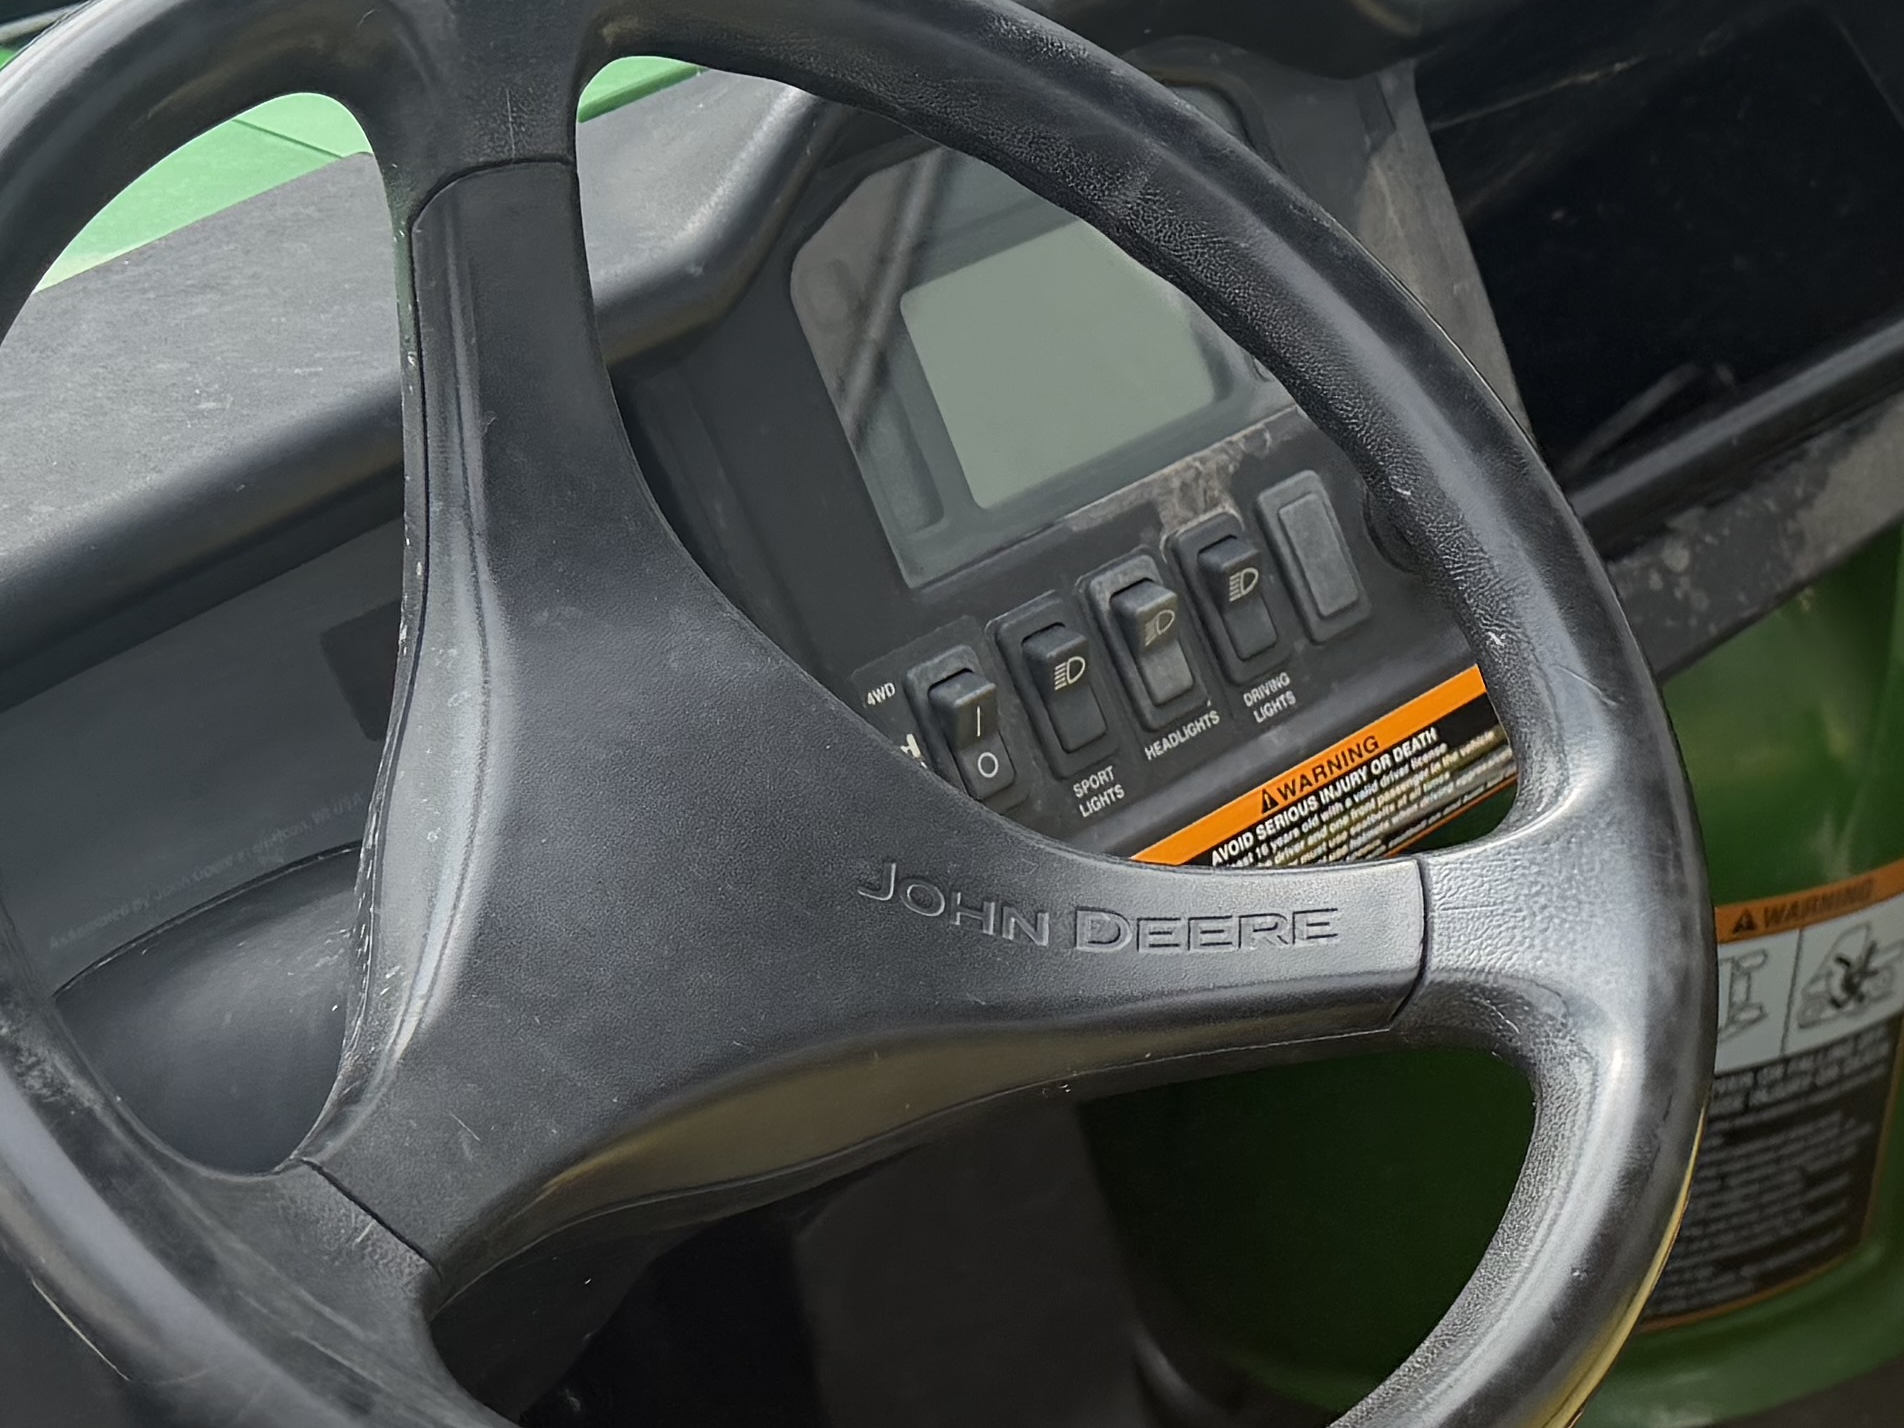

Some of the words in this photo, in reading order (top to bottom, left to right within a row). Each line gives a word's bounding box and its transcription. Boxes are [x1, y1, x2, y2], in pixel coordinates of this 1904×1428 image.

[864, 680, 897, 707] 4WD
[1243, 671, 1290, 707] DRIVING
[1254, 690, 1295, 723] LIGHTS
[1145, 709, 1220, 760] HEADLIGHTS
[1073, 764, 1116, 799] SPORT
[1280, 733, 1378, 801] WARNING
[1079, 782, 1124, 818] LIGHTS
[1210, 830, 1254, 866] AVOID
[1255, 794, 1317, 841] SERIOUS
[1319, 765, 1369, 804] INJURY
[1370, 752, 1392, 775] OR
[1392, 725, 1438, 763] DEATH
[857, 863, 1050, 948] JOHN
[1073, 907, 1339, 956] DEERE
